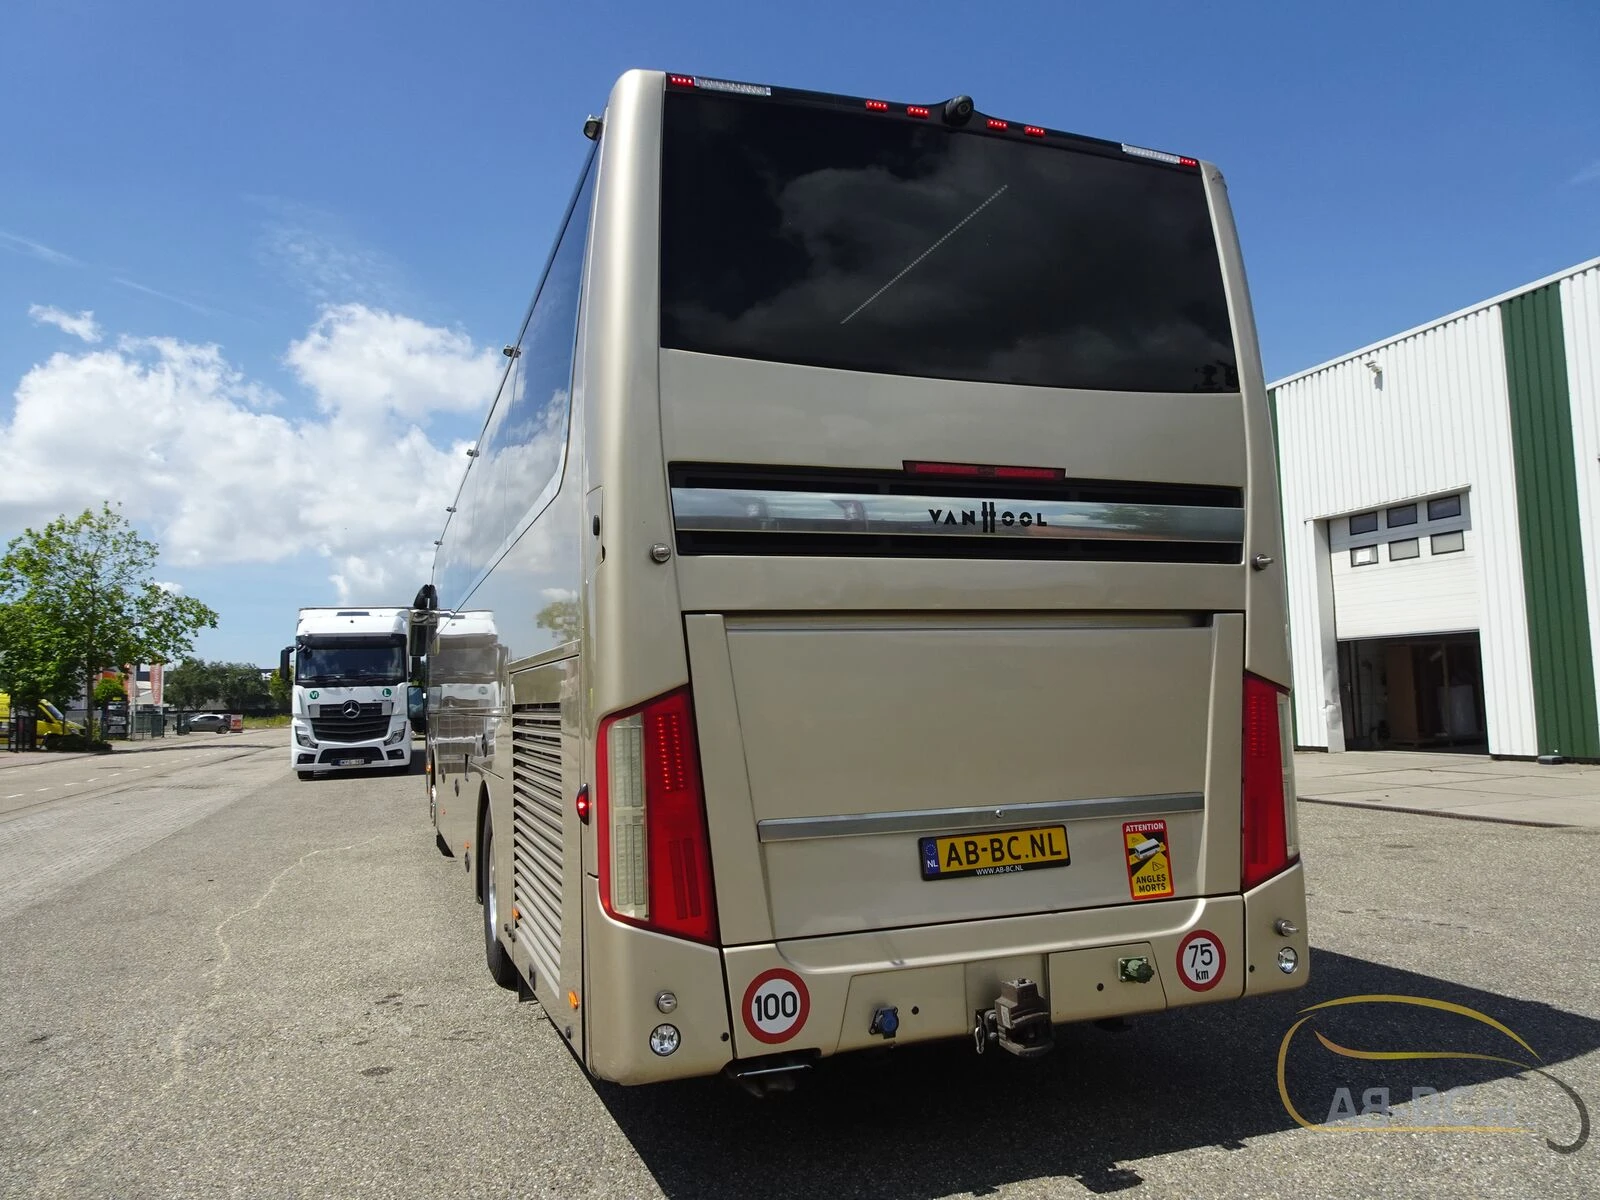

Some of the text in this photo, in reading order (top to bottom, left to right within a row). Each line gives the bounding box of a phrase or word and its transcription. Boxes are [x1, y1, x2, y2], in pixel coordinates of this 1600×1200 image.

[1125, 822, 1164, 833] ATTENTION
[946, 833, 1062, 868] AB-BC.NL
[927, 859, 939, 868] NL
[975, 865, 1024, 876] WWW.AB-BC.NL
[1136, 874, 1166, 884] ANGLES
[1138, 883, 1166, 893] MORTS
[1188, 943, 1213, 968] 75
[1195, 968, 1209, 981] km
[754, 991, 798, 1022] 100
